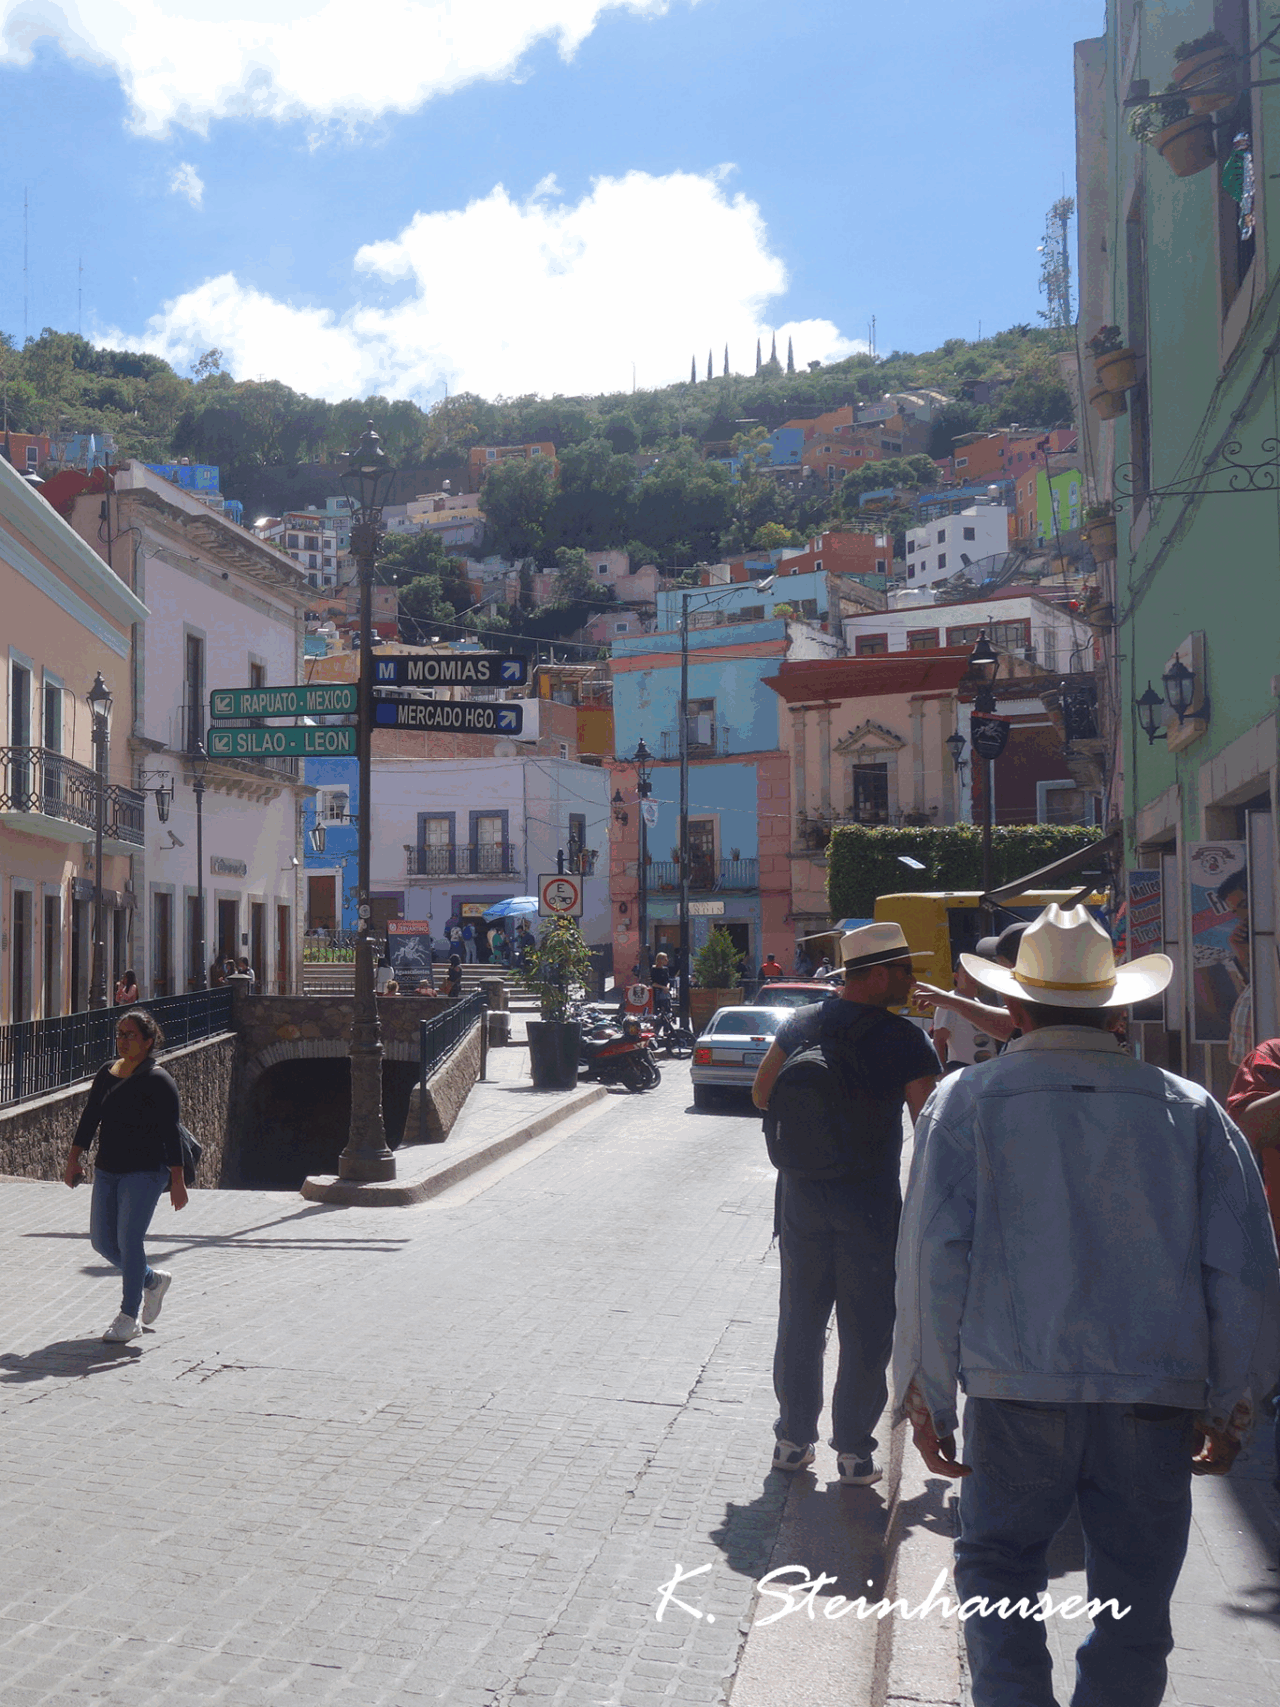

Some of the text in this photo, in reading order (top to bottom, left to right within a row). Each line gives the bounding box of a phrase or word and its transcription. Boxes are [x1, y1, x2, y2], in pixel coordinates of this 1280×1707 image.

[407, 661, 490, 680] MOMIAS
[240, 692, 297, 714] IRAPUATO
[306, 689, 351, 711] MEXICO
[398, 704, 496, 729] MERCADO HGO.
[236, 732, 286, 752] SILAO
[304, 731, 349, 751] LEON
[556, 883, 565, 893] E
